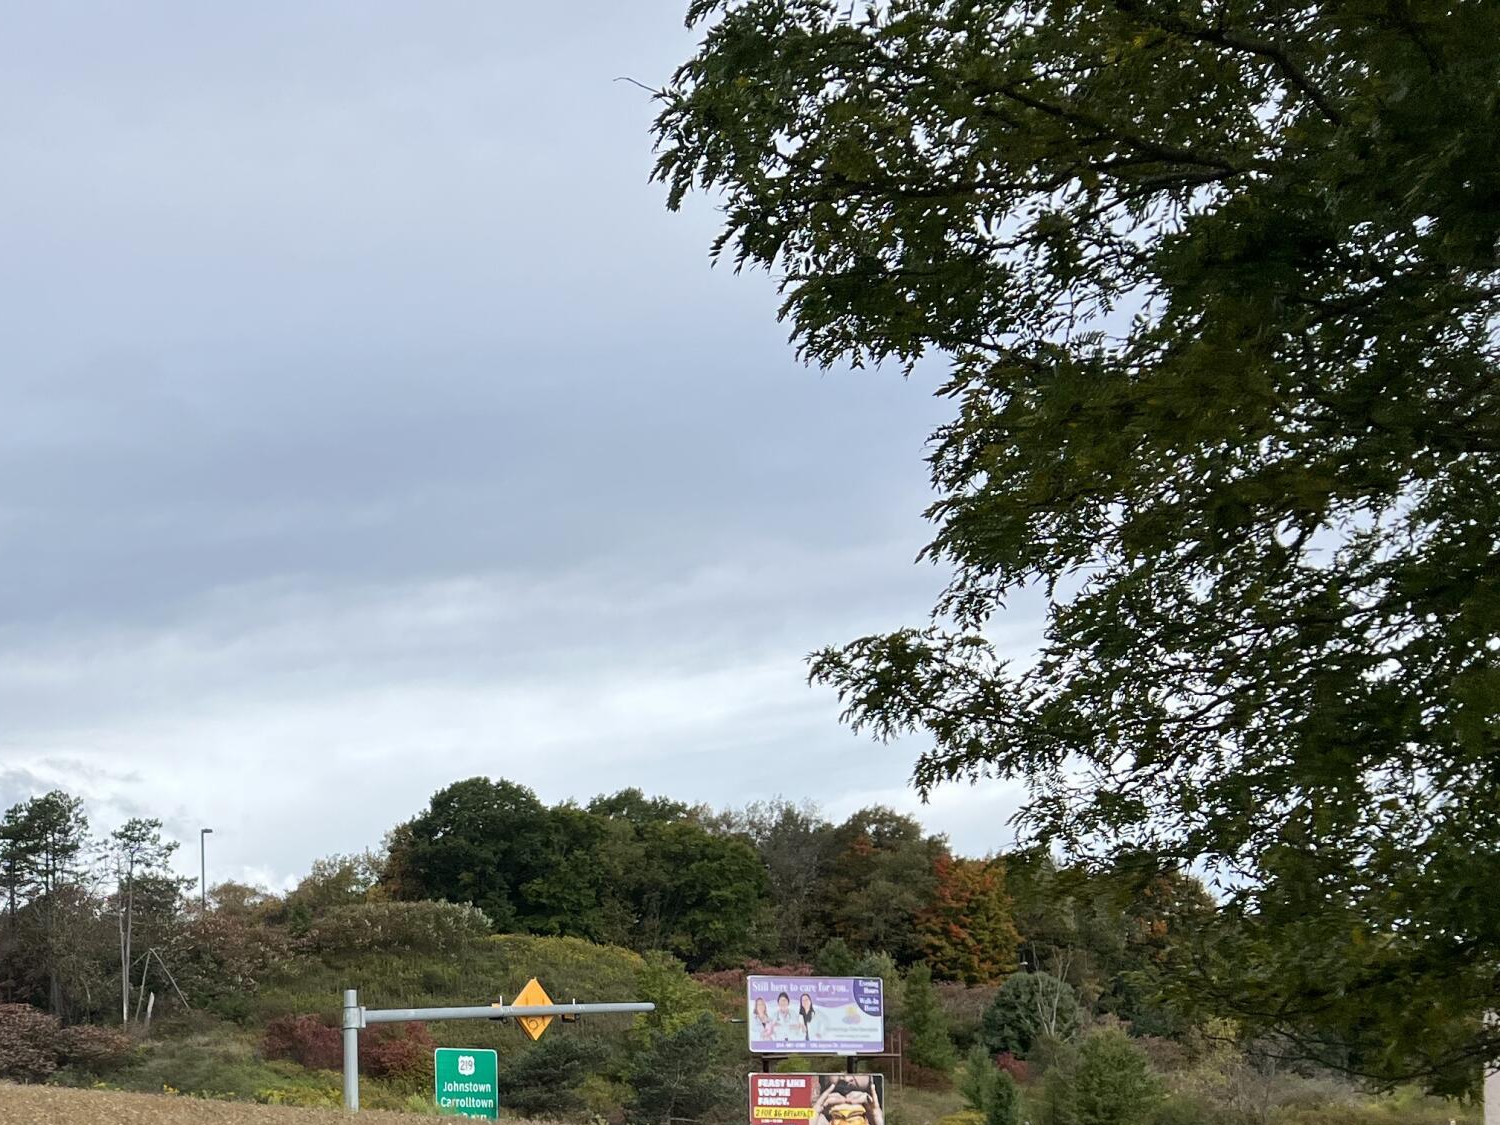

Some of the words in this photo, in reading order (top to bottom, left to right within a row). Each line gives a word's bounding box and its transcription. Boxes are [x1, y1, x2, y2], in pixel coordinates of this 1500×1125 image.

[752, 982, 769, 992] Still
[770, 982, 788, 992] here
[790, 984, 798, 992] to
[800, 984, 816, 992] care
[818, 982, 830, 992] for
[460, 1060, 473, 1071] 219
[442, 1081, 491, 1092] Johnstown
[758, 1078, 786, 1088] FEAST
[786, 1079, 806, 1088] LIKE
[758, 1088, 790, 1097] YOU'RE
[440, 1097, 494, 1108] Carrolltown
[758, 1097, 790, 1106] FANCY.
[761, 1109, 772, 1117] FOR
